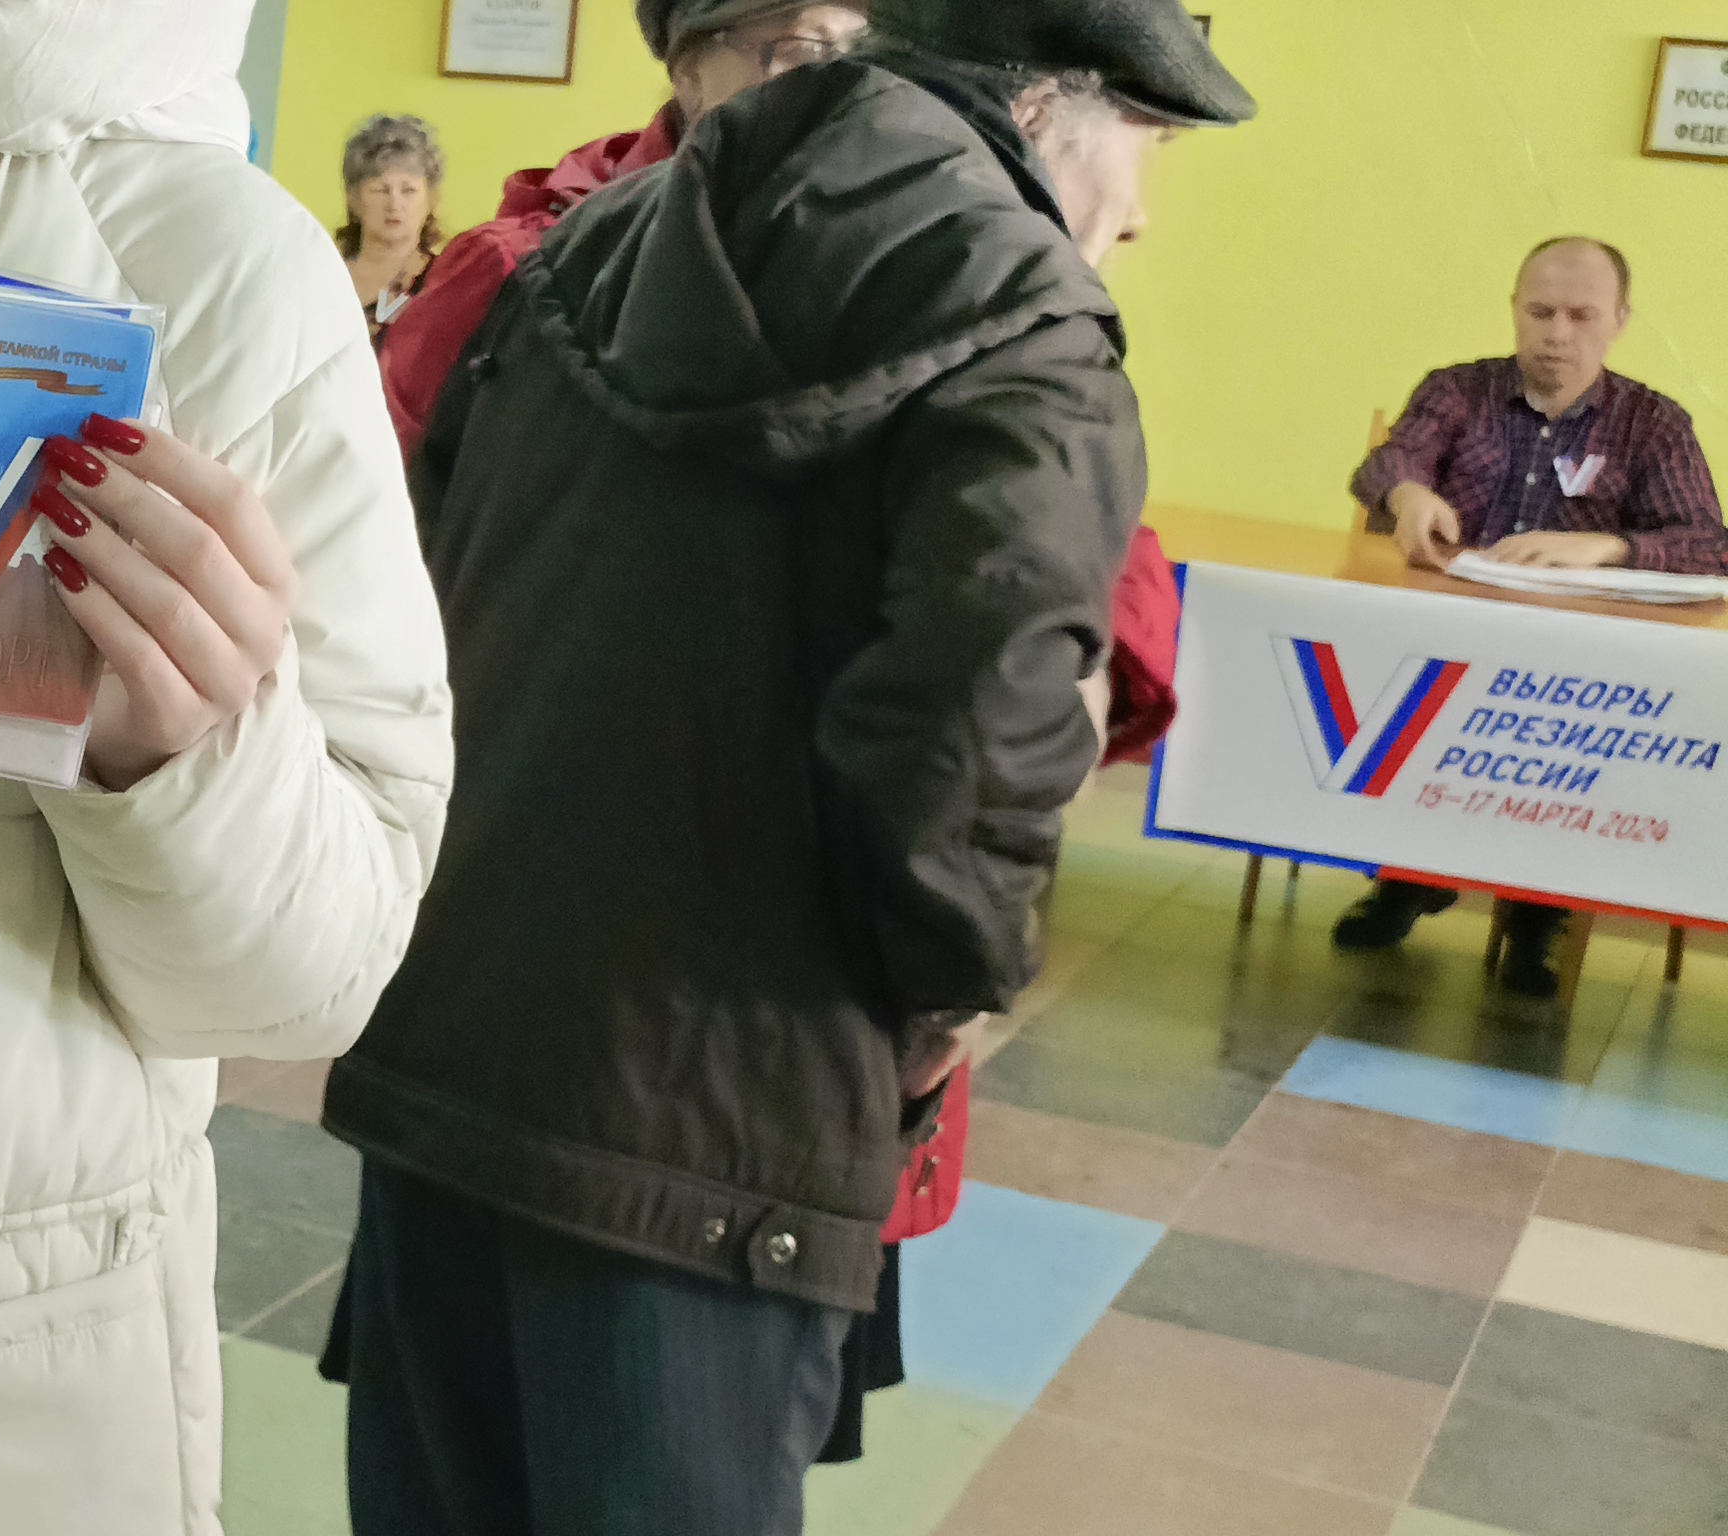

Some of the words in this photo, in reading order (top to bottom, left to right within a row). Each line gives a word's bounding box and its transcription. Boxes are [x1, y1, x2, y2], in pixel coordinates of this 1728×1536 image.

[1673, 87, 1728, 111] РОСС
[62, 351, 128, 373] СТРАНЫ
[1486, 667, 1674, 720] ВЫБОРЫ
[1460, 707, 1722, 772] ПРЕЗИДЕНТА
[1434, 745, 1602, 795] РОССИИ
[1494, 795, 1595, 833] МАРТА
[1596, 810, 1670, 843] 2024
